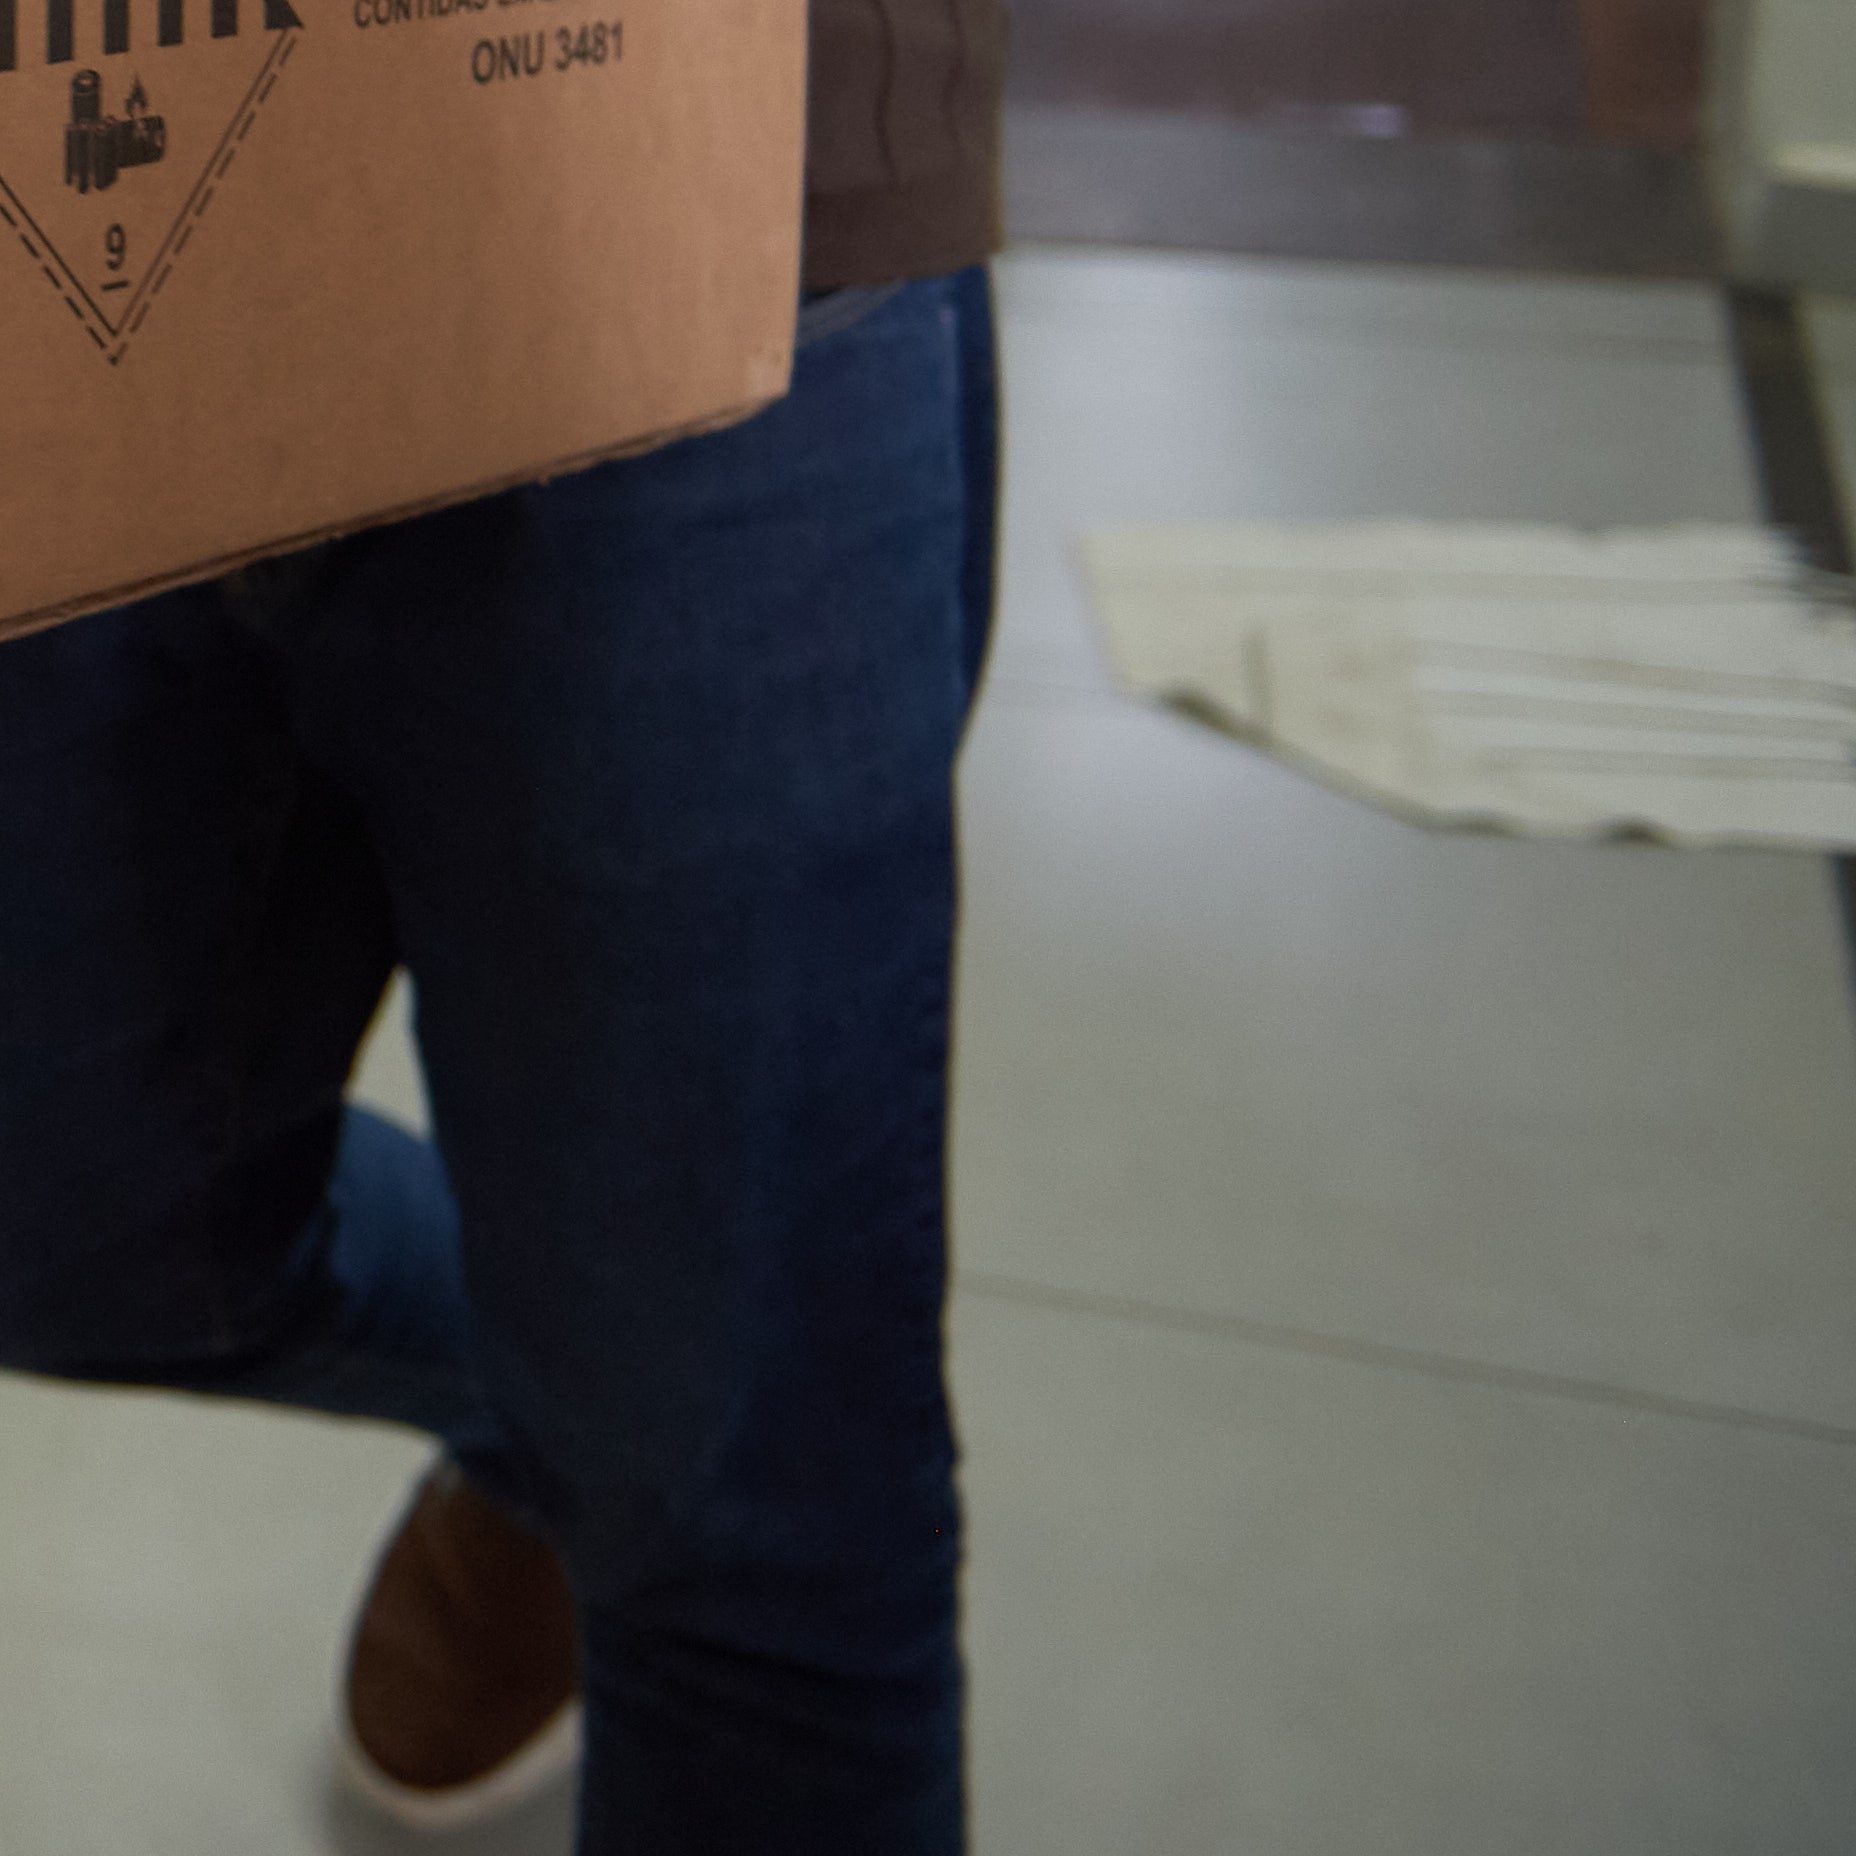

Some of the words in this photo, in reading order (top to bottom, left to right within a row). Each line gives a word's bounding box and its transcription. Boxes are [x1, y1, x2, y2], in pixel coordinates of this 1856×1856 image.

[471, 30, 546, 86] ONU
[554, 20, 624, 72] 3481
[106, 223, 126, 271] 9
